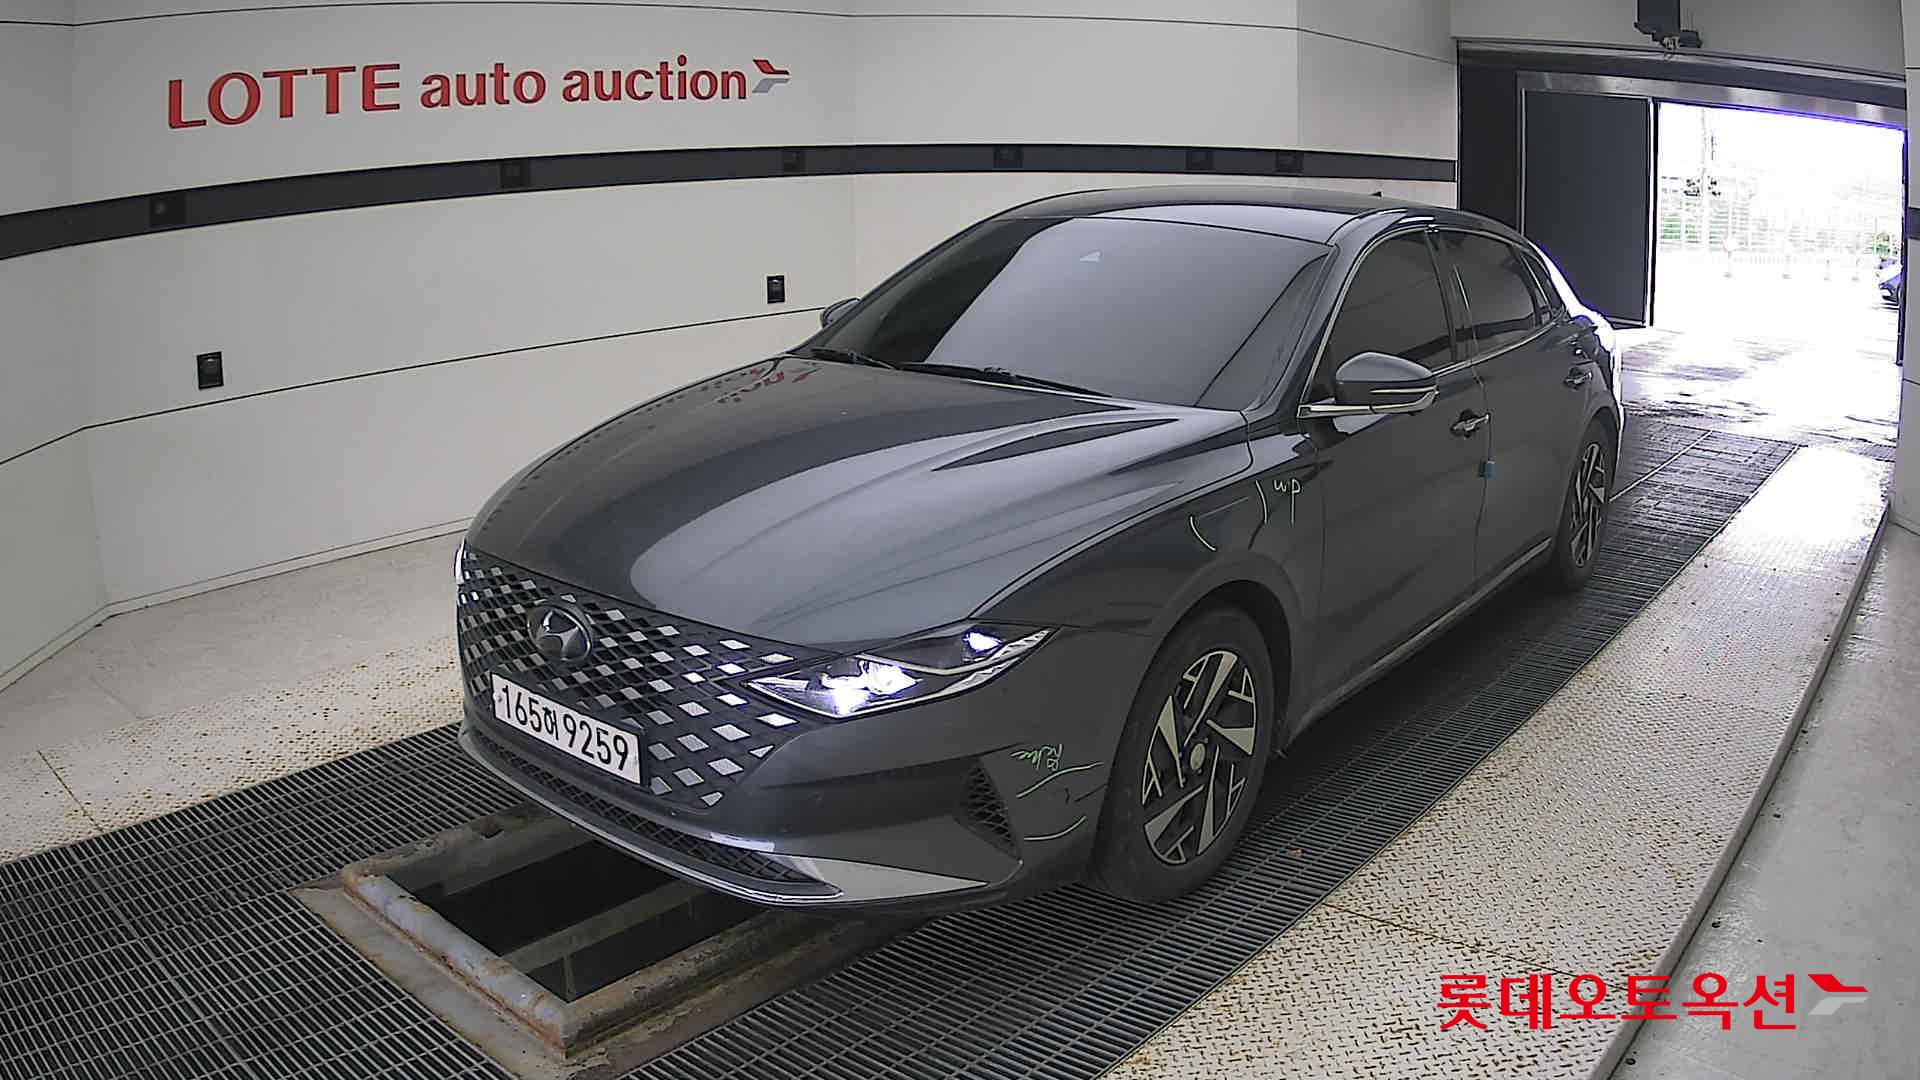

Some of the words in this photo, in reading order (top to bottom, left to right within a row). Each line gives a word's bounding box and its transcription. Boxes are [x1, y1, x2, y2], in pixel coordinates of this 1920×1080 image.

[167, 62, 401, 129] LOTTE
[419, 62, 546, 108] auto
[562, 54, 748, 103] auction
